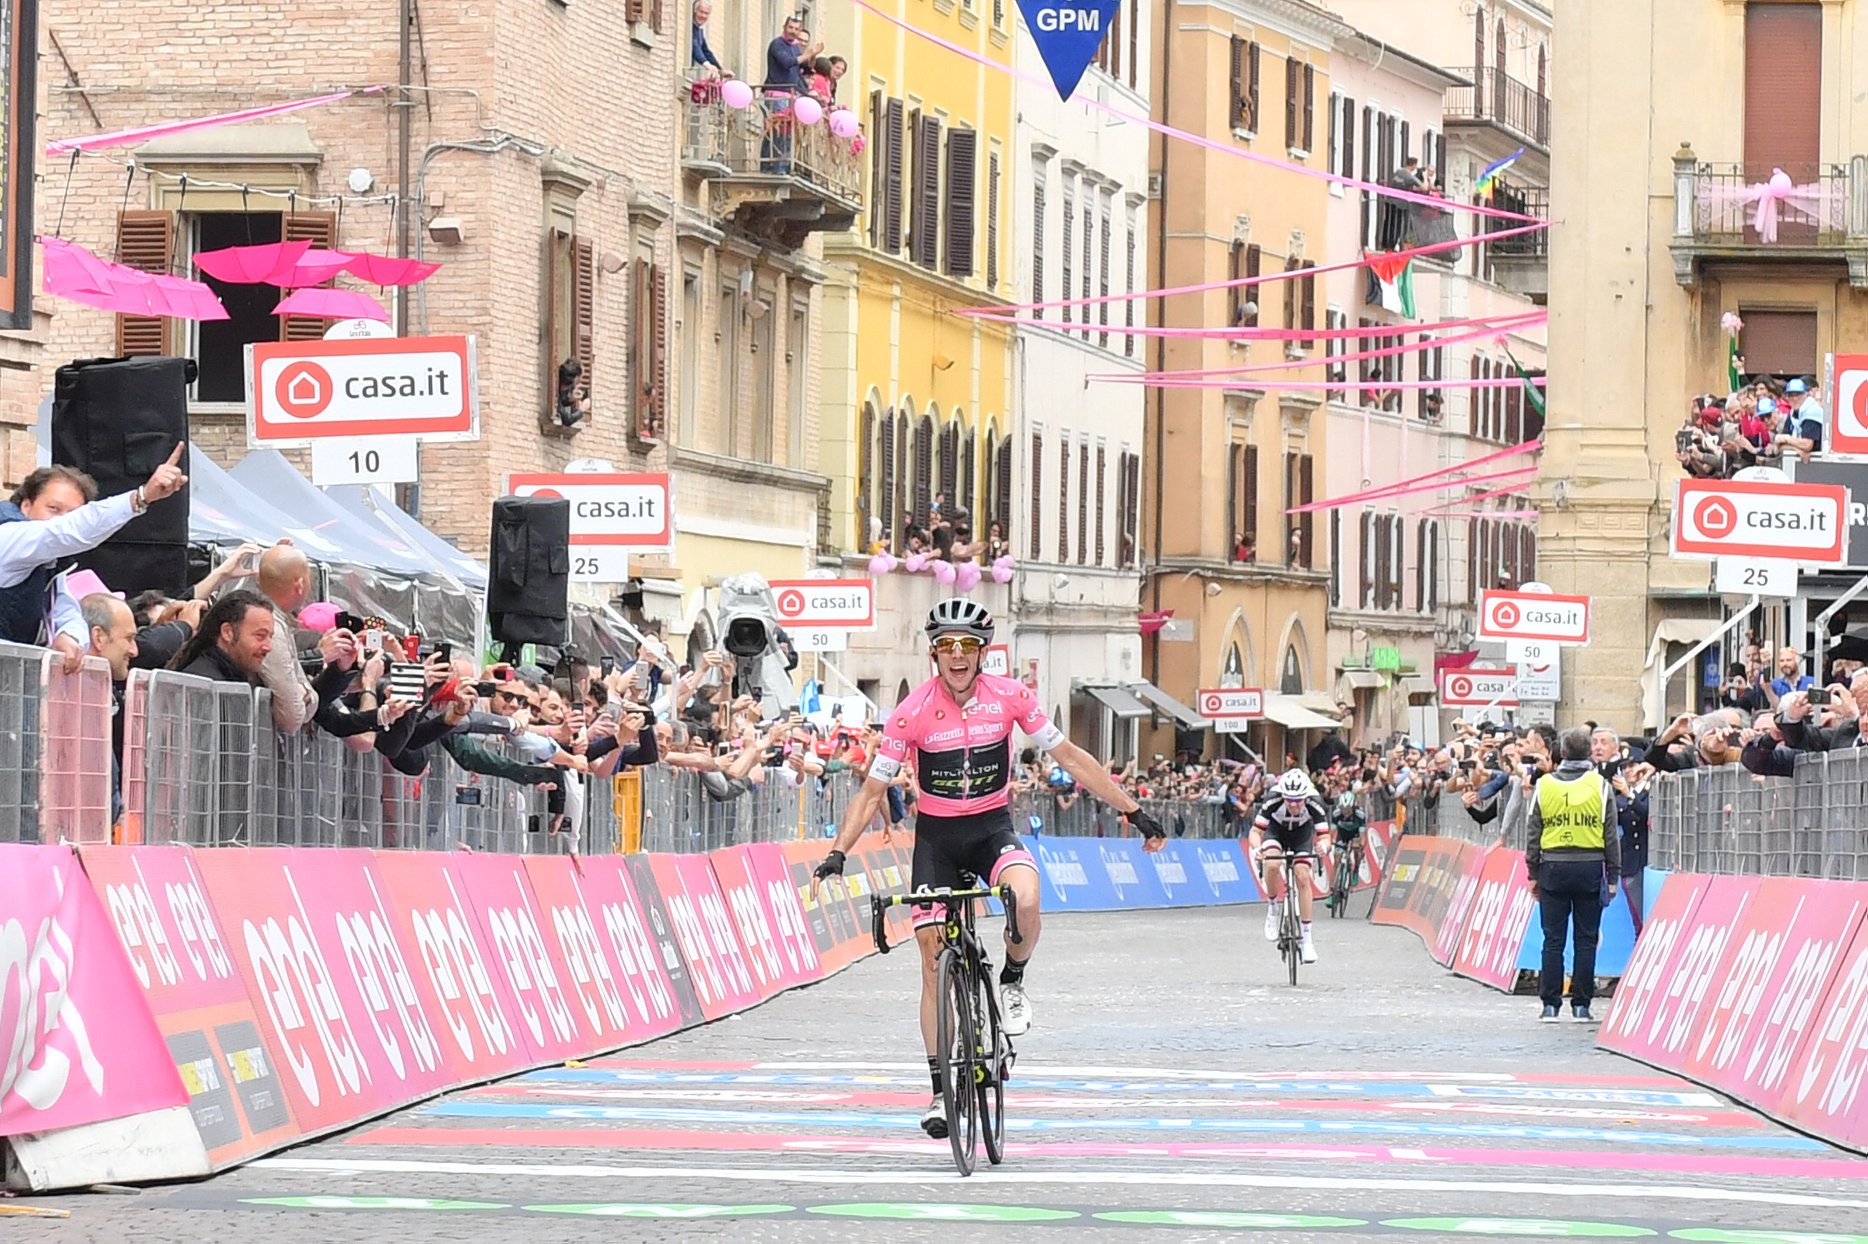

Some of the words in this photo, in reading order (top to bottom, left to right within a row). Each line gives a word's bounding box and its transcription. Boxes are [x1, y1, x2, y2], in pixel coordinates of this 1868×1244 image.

[1036, 8, 1099, 31] GPM
[345, 367, 449, 398] casa.it
[348, 450, 380, 473] 10
[576, 496, 655, 518] casa.it
[574, 558, 599, 575] 25
[1746, 508, 1826, 531] casa.it
[811, 594, 863, 609] casa.it
[1526, 610, 1578, 626] casa.it
[1743, 568, 1769, 586] 25
[812, 634, 828, 646] 50
[1524, 646, 1541, 658] 50
[1223, 721, 1239, 729] 100
[1225, 697, 1257, 707] casa.it
[931, 763, 999, 778] MITCHLTON
[1563, 791, 1569, 807] 1
[1574, 811, 1598, 828] LINE
[106, 854, 184, 989] enel
[165, 856, 233, 982] enel
[411, 867, 516, 1062] enel
[488, 870, 579, 1048] enel
[552, 870, 631, 1037] enel
[602, 868, 674, 1025] enel
[668, 865, 726, 1006] enel
[699, 865, 754, 997] enel
[729, 855, 784, 986] enel
[767, 854, 818, 975] enel
[1461, 860, 1518, 969] enel
[1606, 887, 1698, 1038] enel
[243, 865, 373, 1107] enel
[336, 866, 443, 1081] enel
[1648, 890, 1749, 1054] enel
[1696, 895, 1806, 1071] enel
[1744, 900, 1860, 1092] enel
